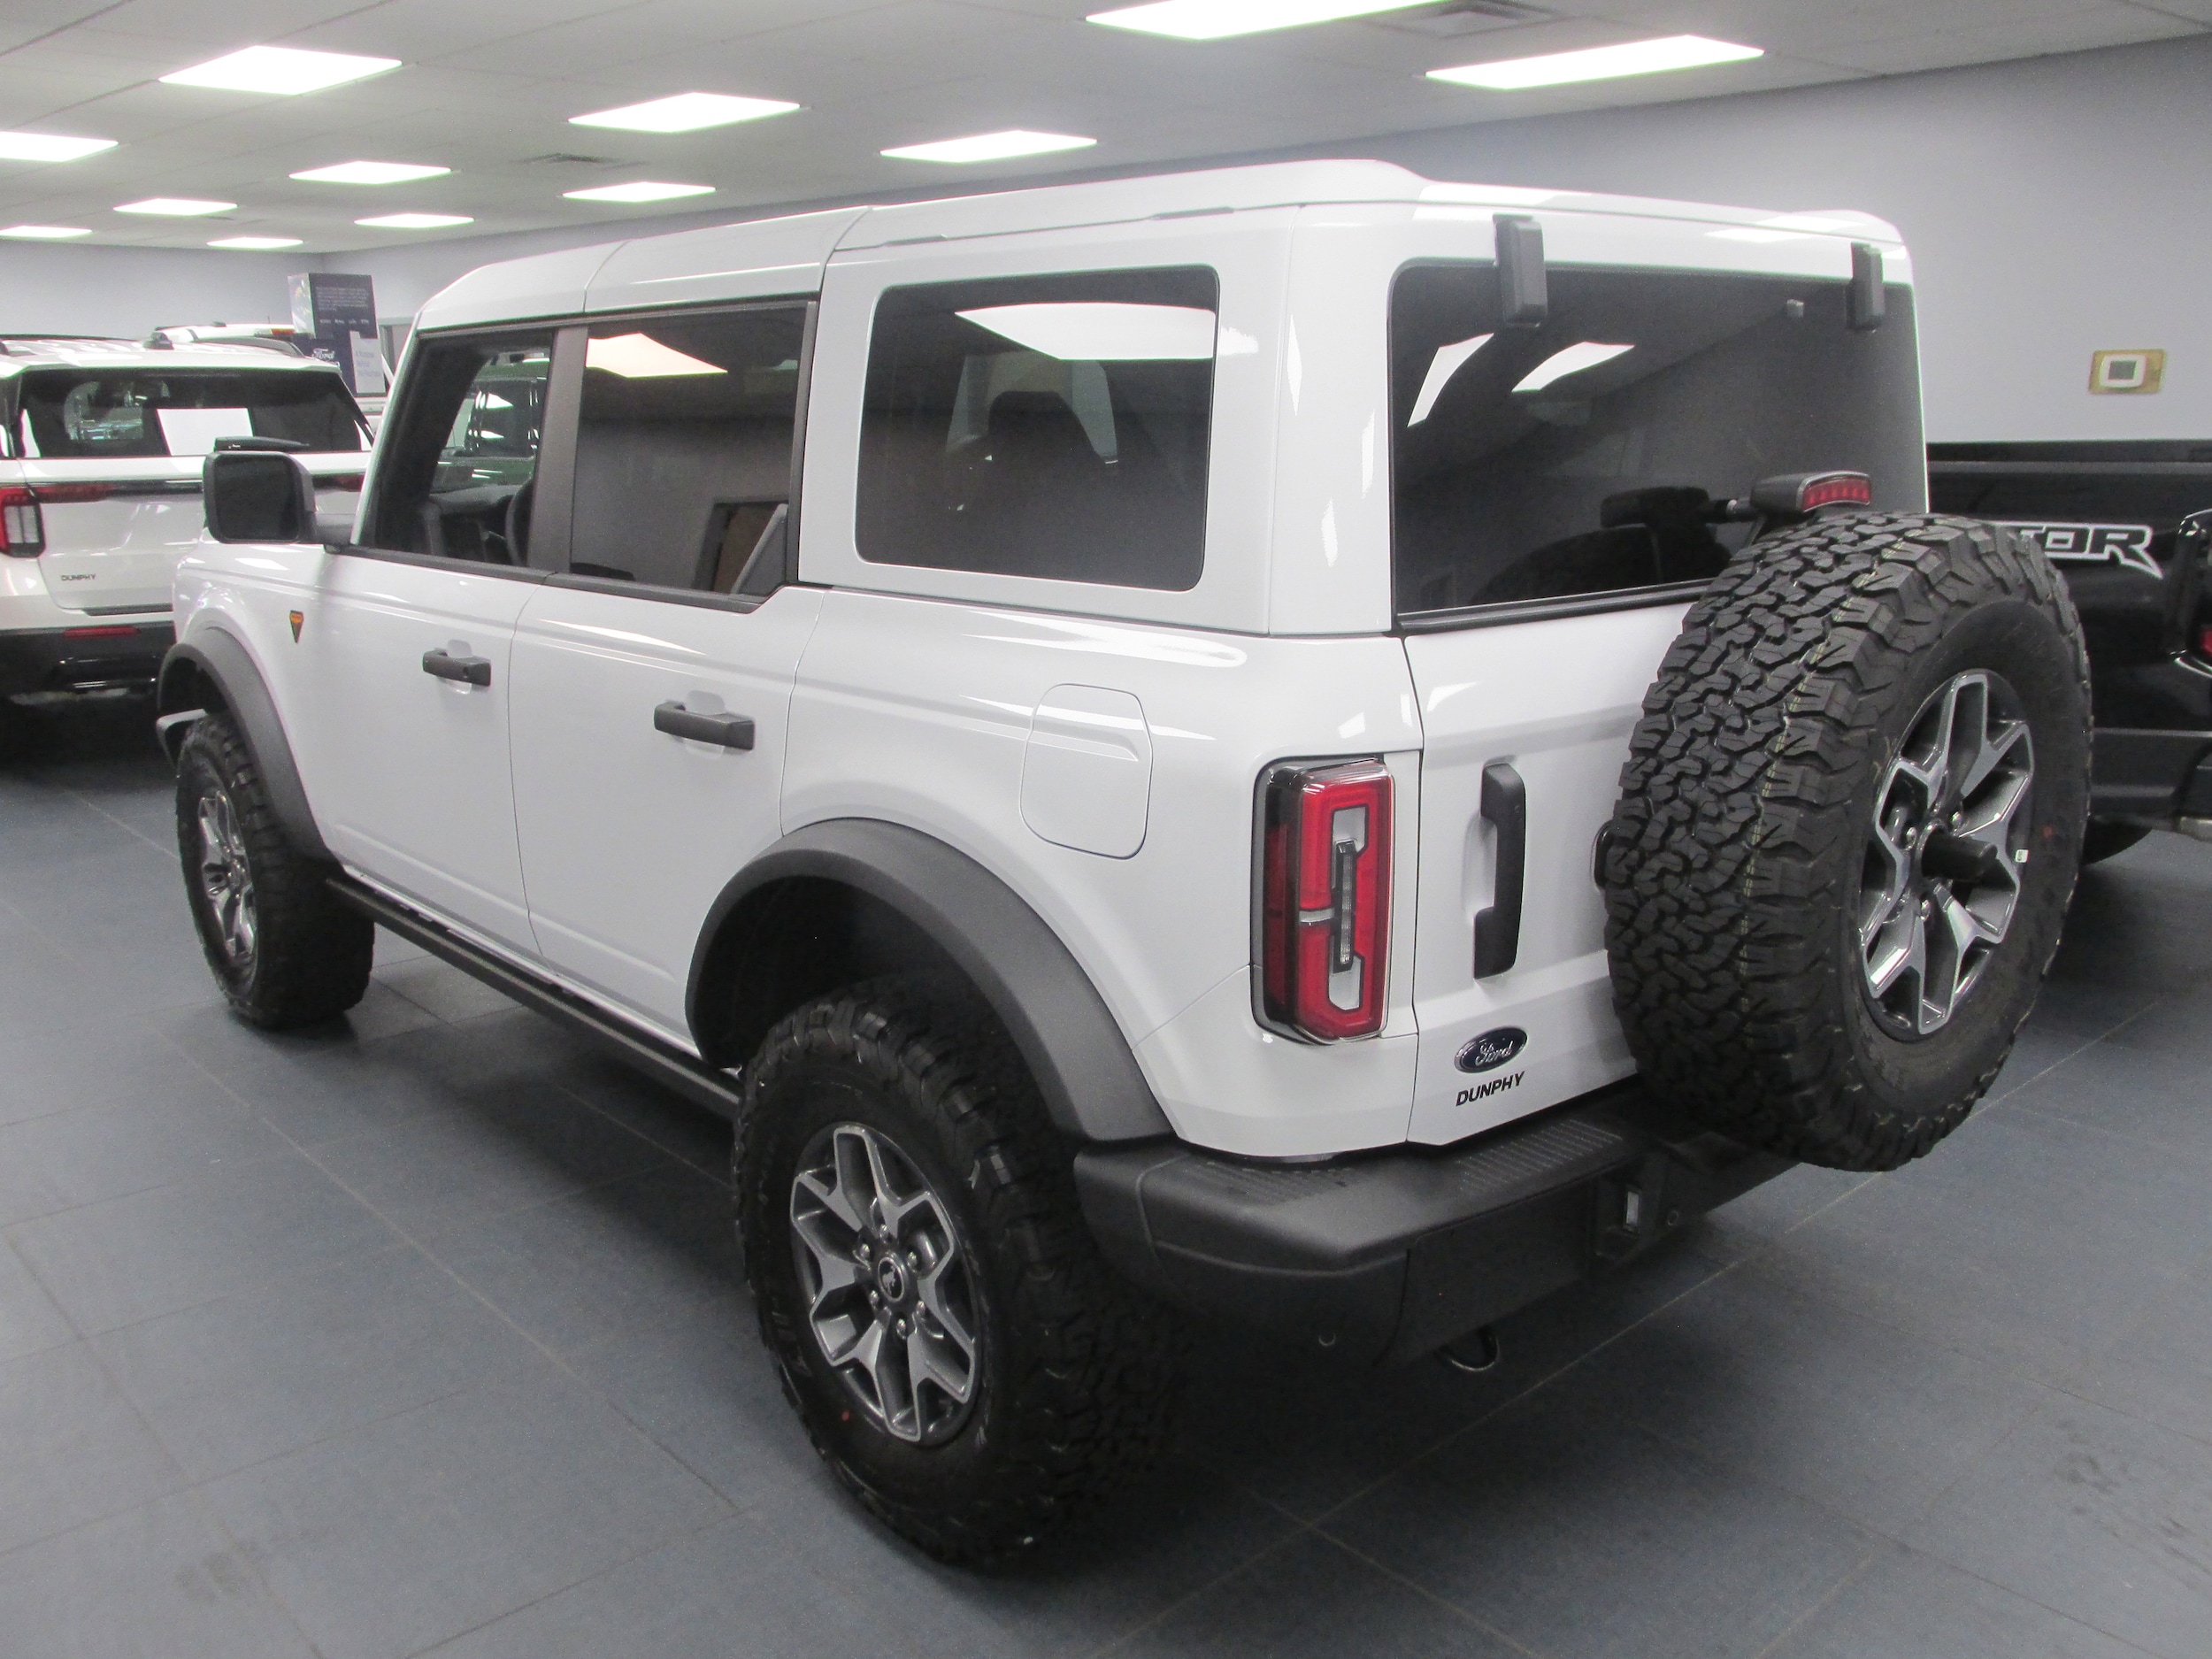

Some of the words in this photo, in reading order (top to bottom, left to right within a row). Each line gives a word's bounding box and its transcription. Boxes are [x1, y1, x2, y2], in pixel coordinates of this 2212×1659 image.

[312, 348, 335, 360] Ford
[1475, 1039, 1515, 1066] Ford
[1456, 1071, 1525, 1107] DUNPHY
